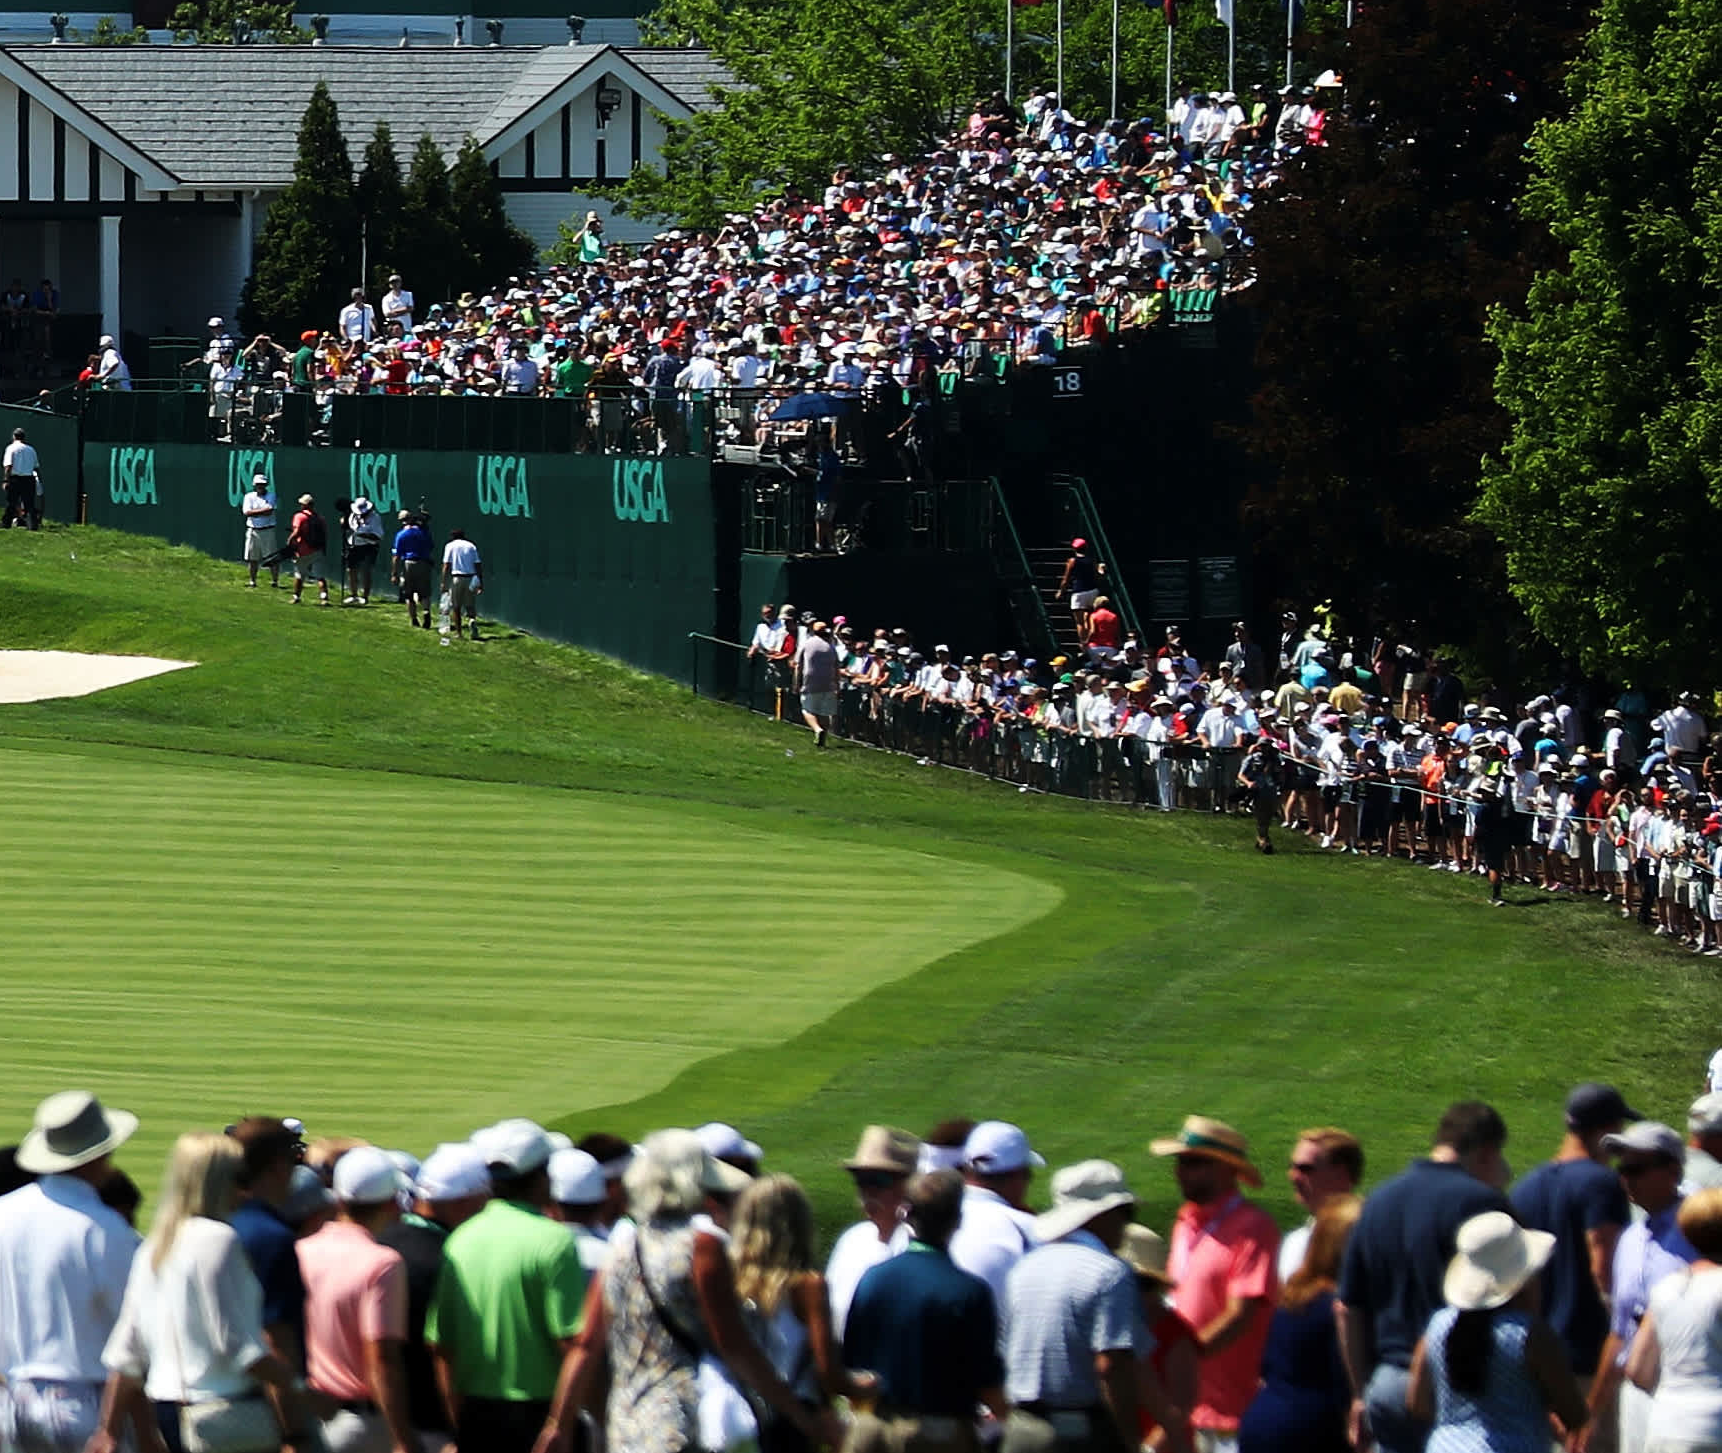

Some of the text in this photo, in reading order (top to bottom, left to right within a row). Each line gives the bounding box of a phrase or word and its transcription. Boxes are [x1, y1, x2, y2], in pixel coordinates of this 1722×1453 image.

[110, 447, 157, 505] USGA
[350, 453, 402, 514] USGA
[477, 455, 532, 518] USGA
[613, 459, 670, 522] USGA
